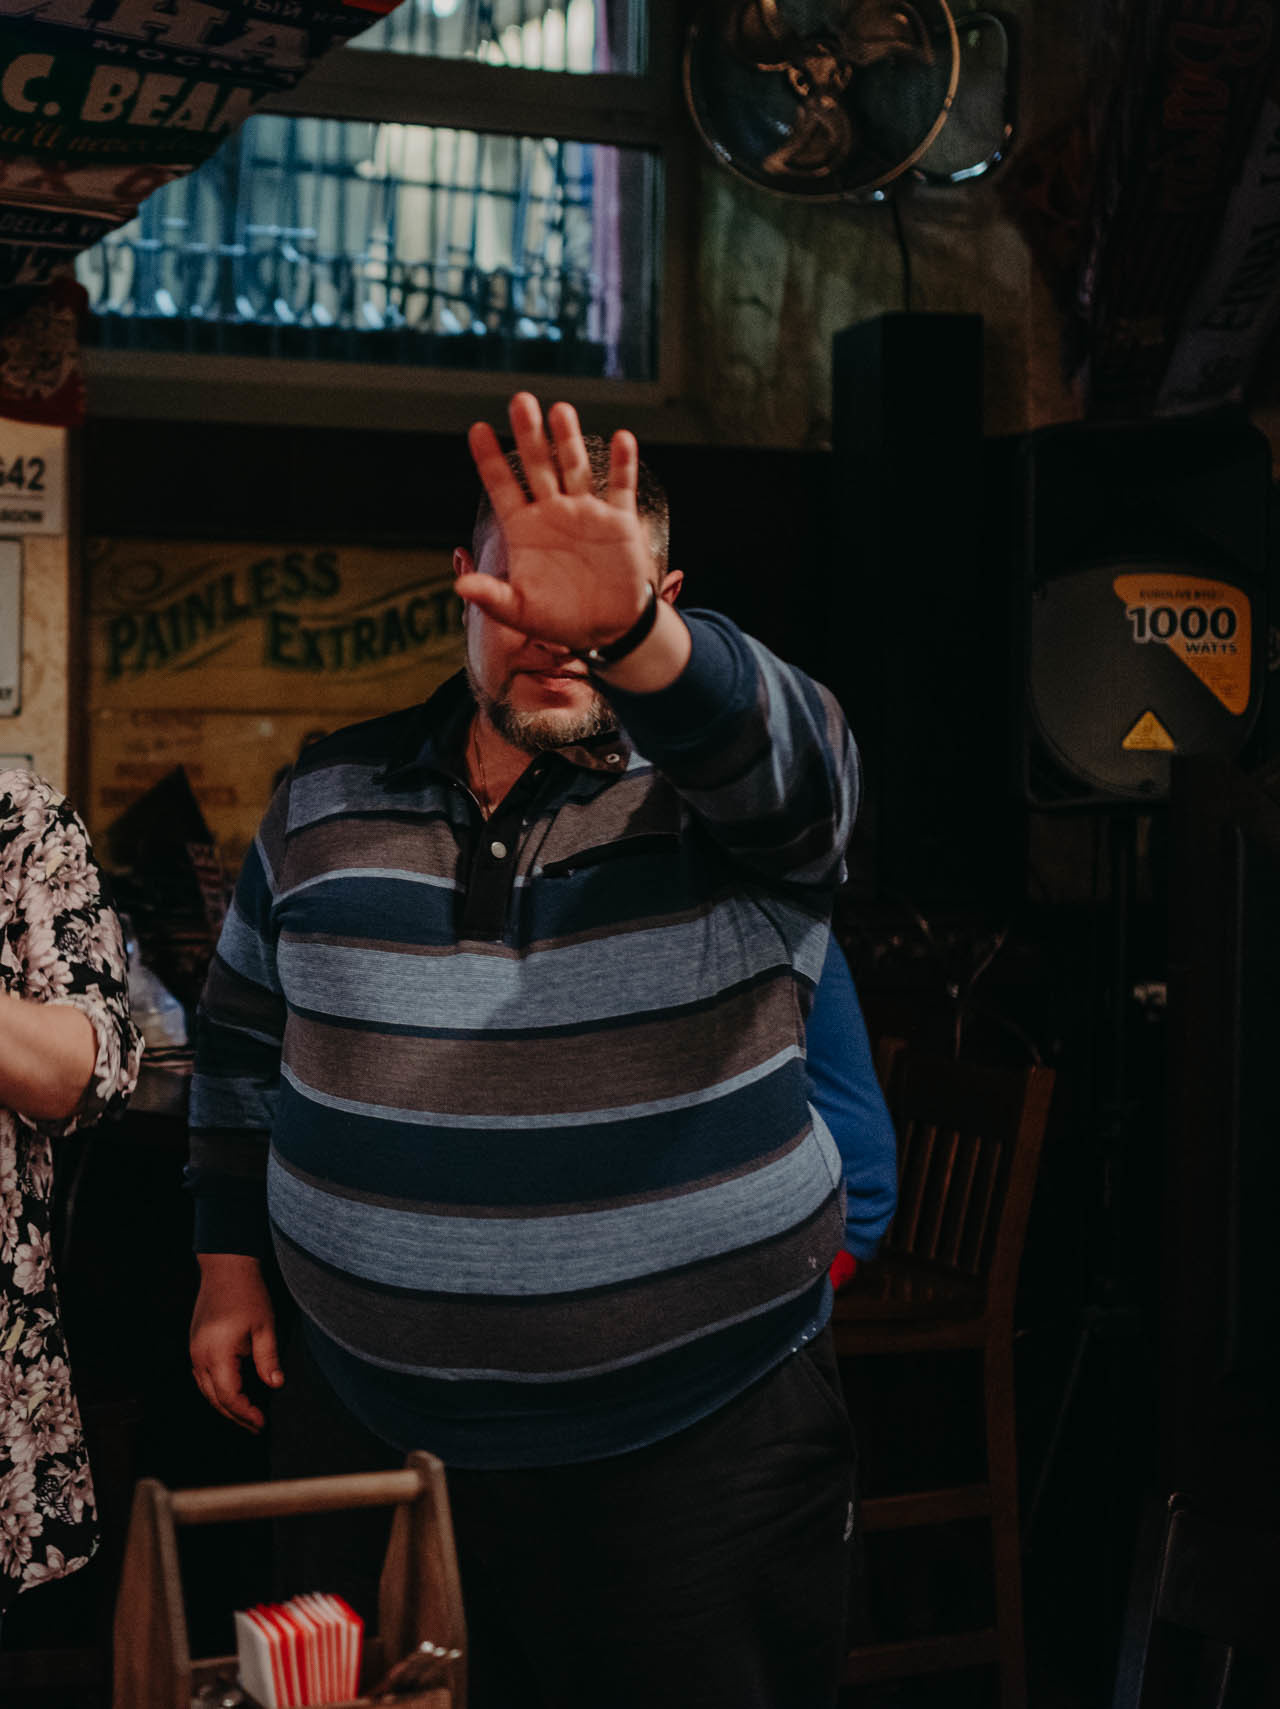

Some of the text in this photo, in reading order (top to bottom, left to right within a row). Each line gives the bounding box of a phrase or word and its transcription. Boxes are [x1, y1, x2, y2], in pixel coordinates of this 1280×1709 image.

[105, 552, 341, 682] PAINLESS
[1128, 607, 1237, 639] 1000
[1184, 641, 1238, 654] WATTS
